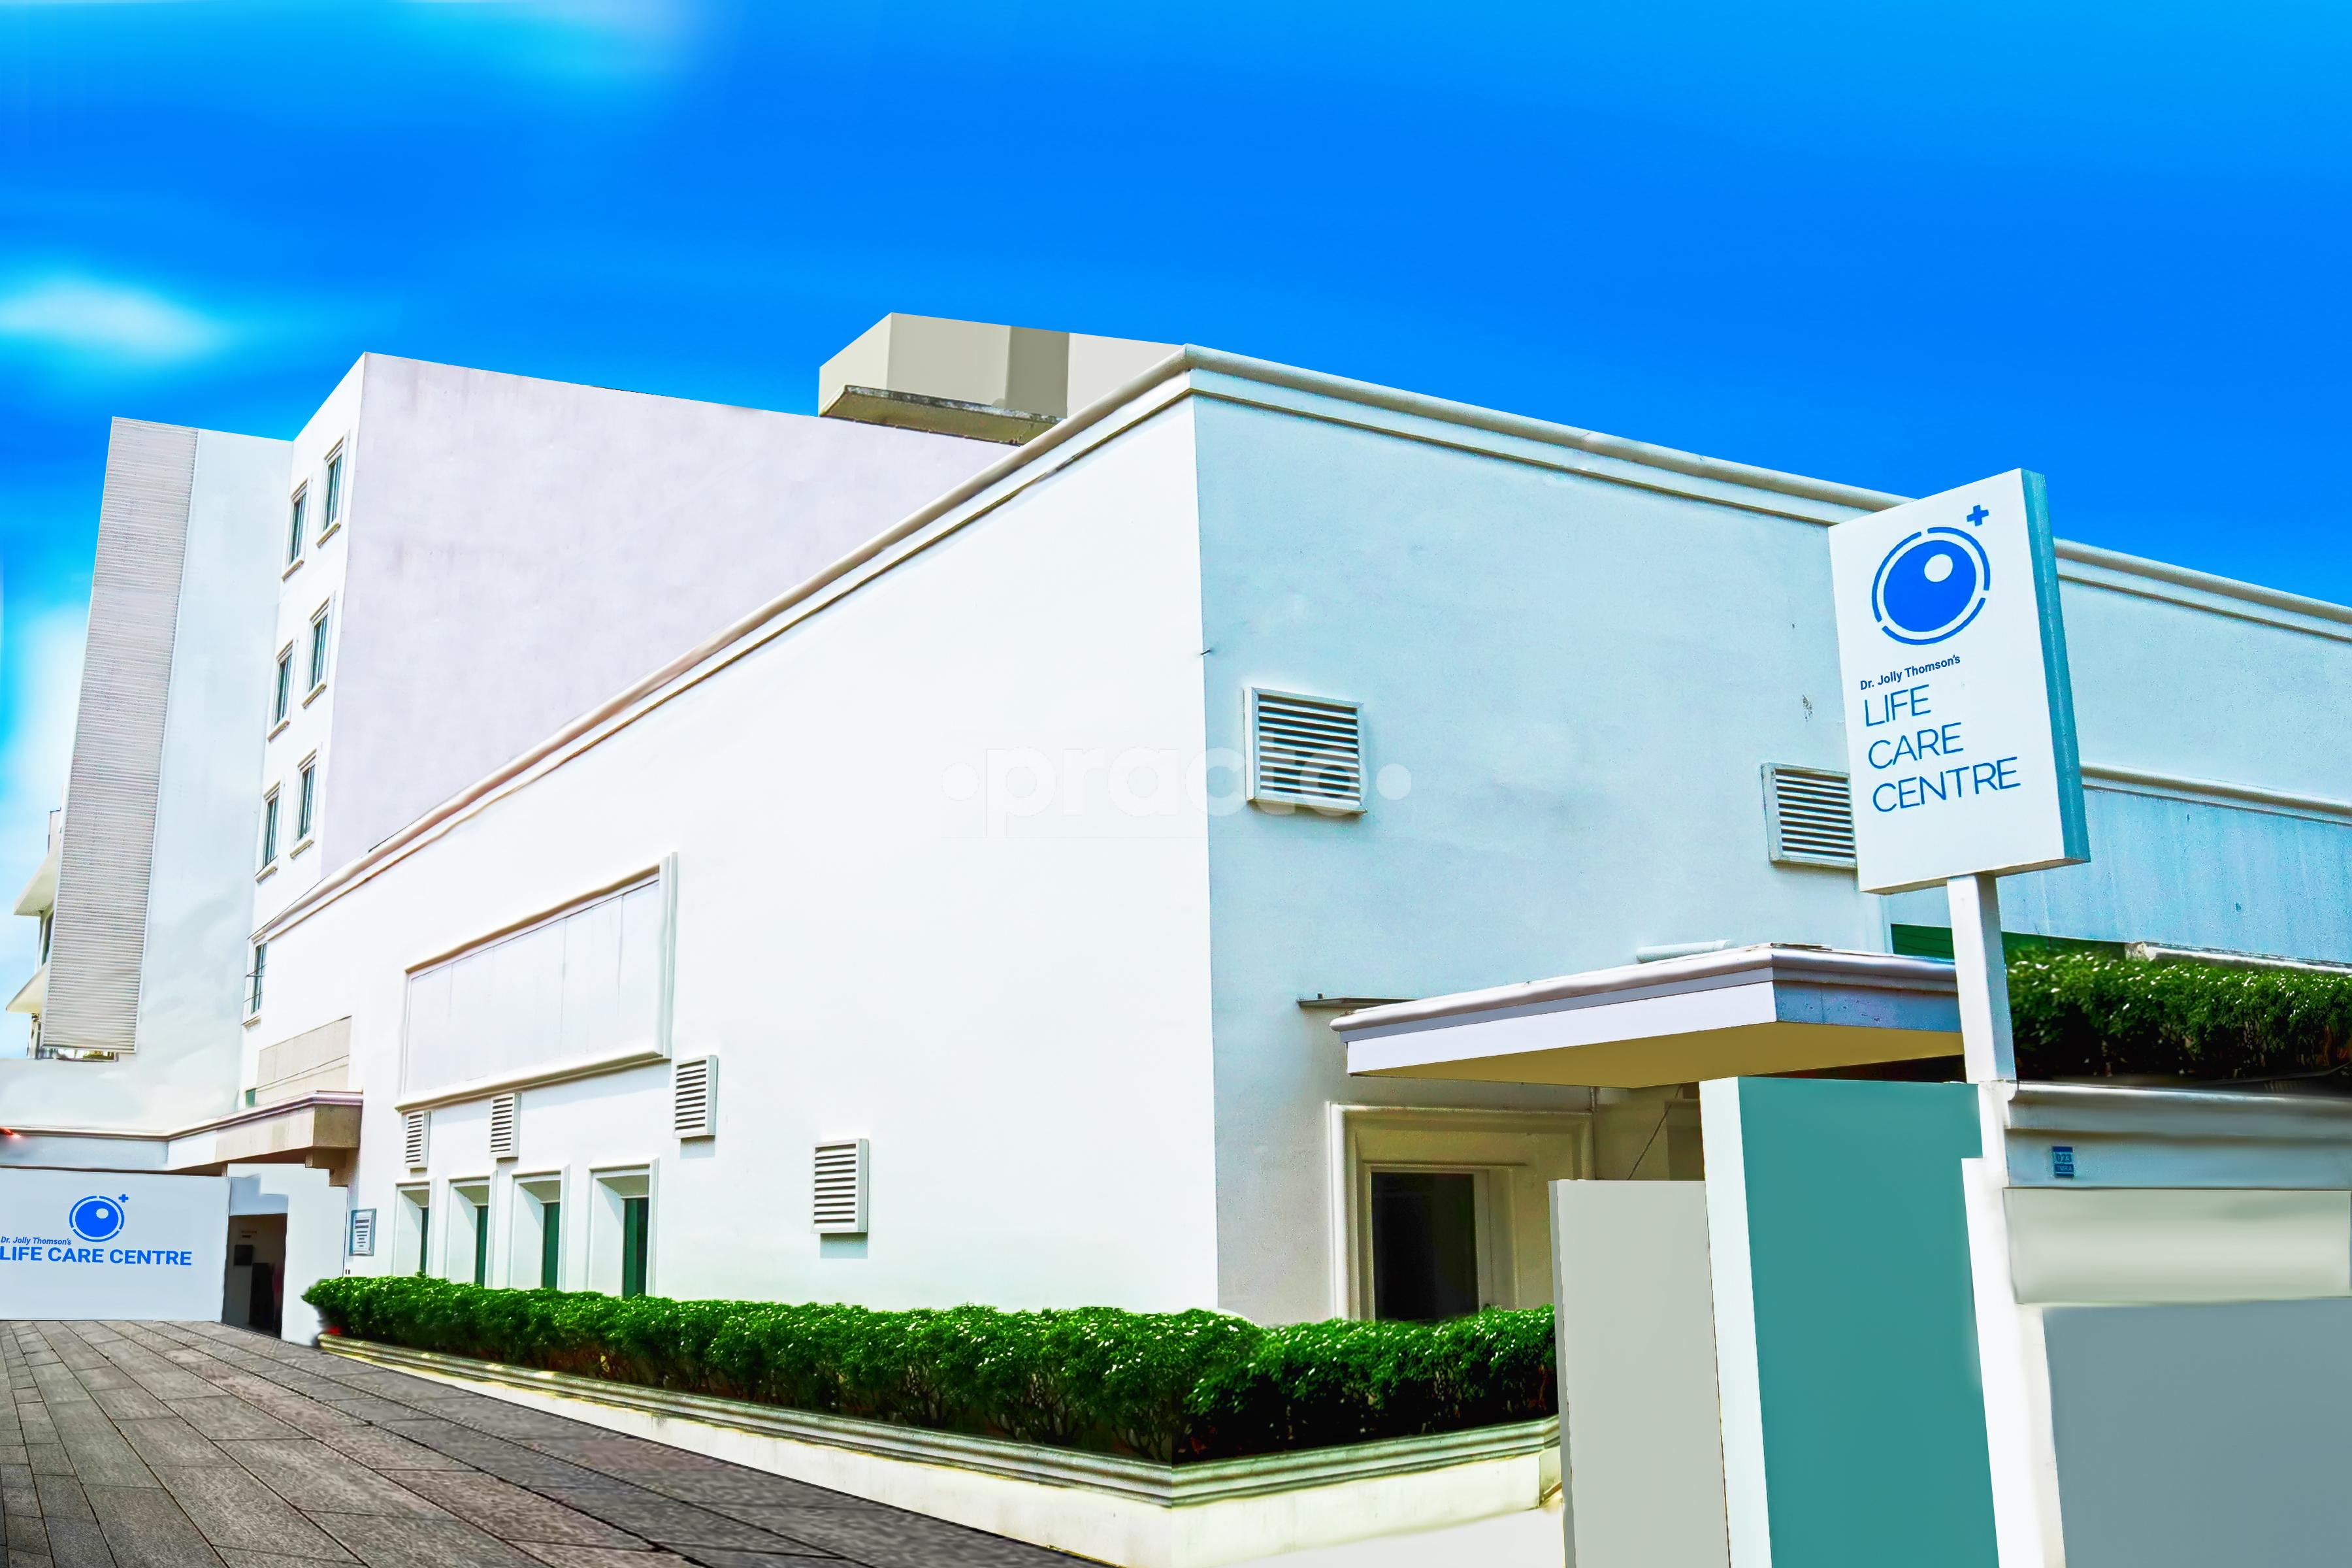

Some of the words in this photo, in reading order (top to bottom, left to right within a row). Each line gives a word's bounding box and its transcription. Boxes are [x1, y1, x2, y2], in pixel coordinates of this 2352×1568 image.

[1860, 680, 1874, 690] Dr.
[1877, 671, 1903, 685] Jolly
[1904, 654, 1961, 678] Thomson's
[1864, 684, 1931, 727] LIFE
[1868, 722, 1964, 770] CARE
[1872, 757, 2021, 813] CENTRE
[0, 1246, 42, 1261] LIFE
[48, 1247, 104, 1263] CARE
[109, 1249, 192, 1266] CENTRE
[12, 1237, 31, 1245] Jolly
[33, 1237, 72, 1245] Thomson's
